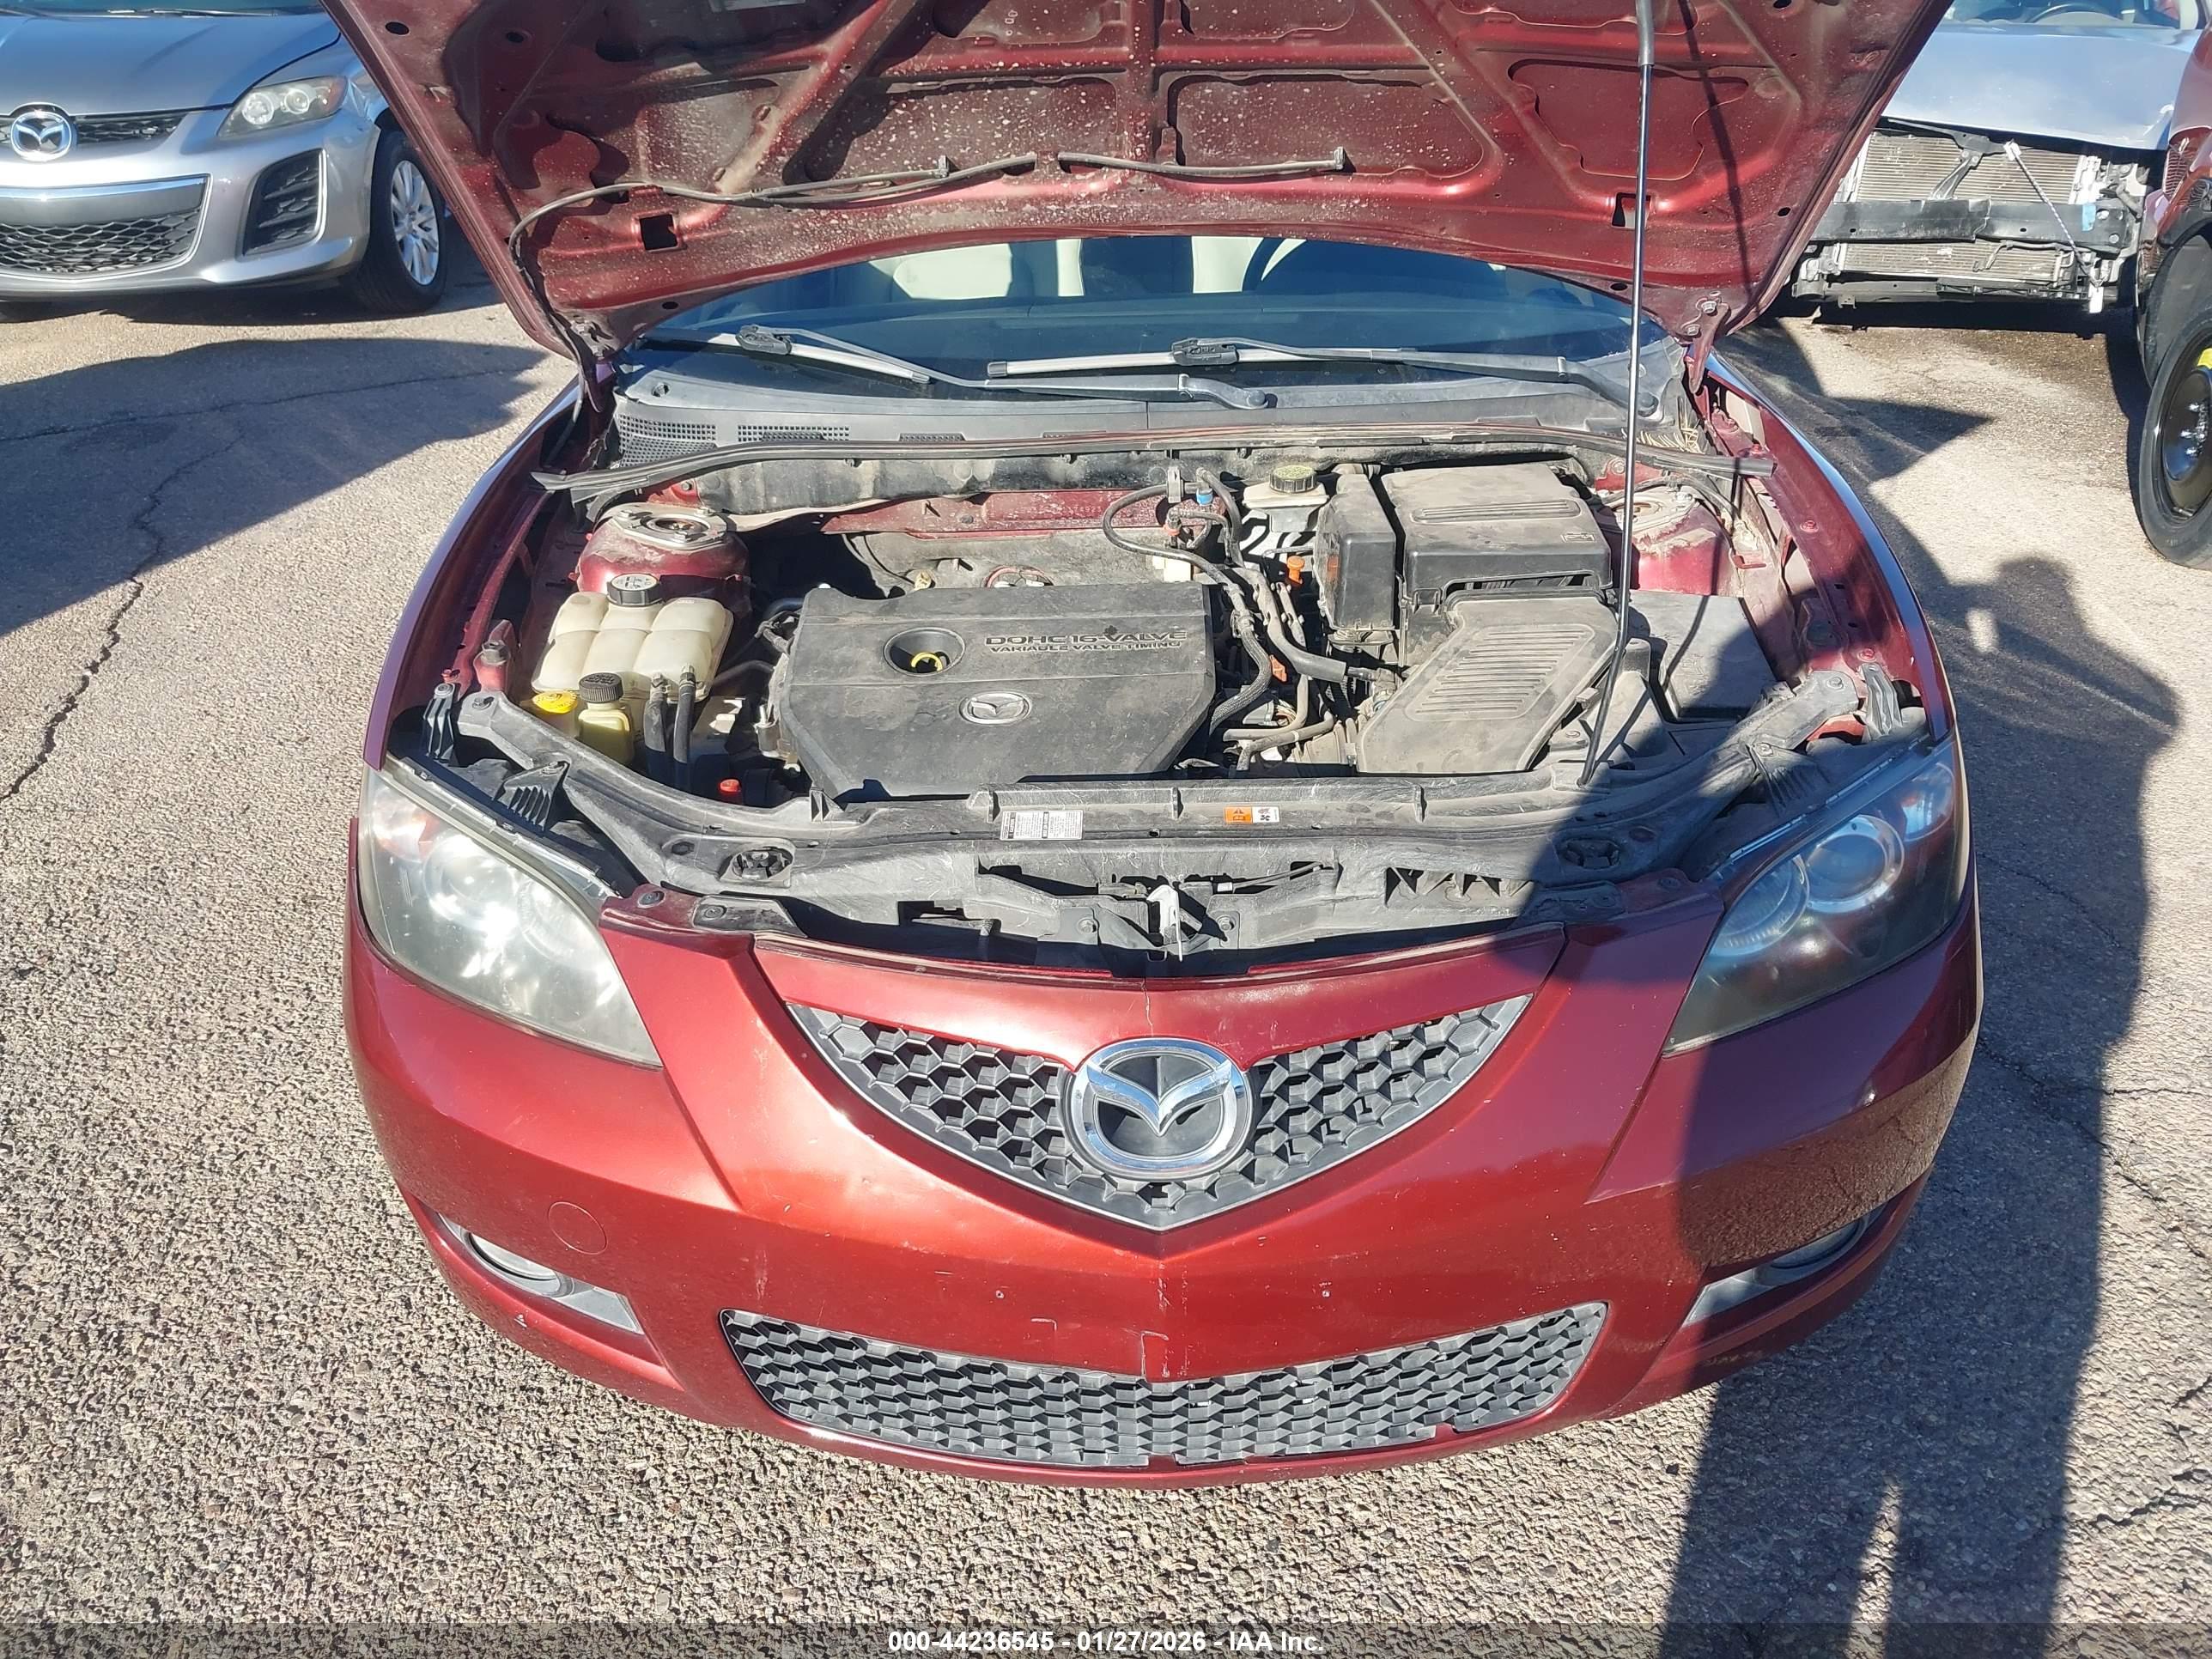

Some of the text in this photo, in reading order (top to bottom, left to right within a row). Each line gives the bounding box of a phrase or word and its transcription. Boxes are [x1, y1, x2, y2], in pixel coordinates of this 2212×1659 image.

[985, 630, 1188, 645] DOHC 16-VALVE
[1126, 641, 1182, 650] TIMING
